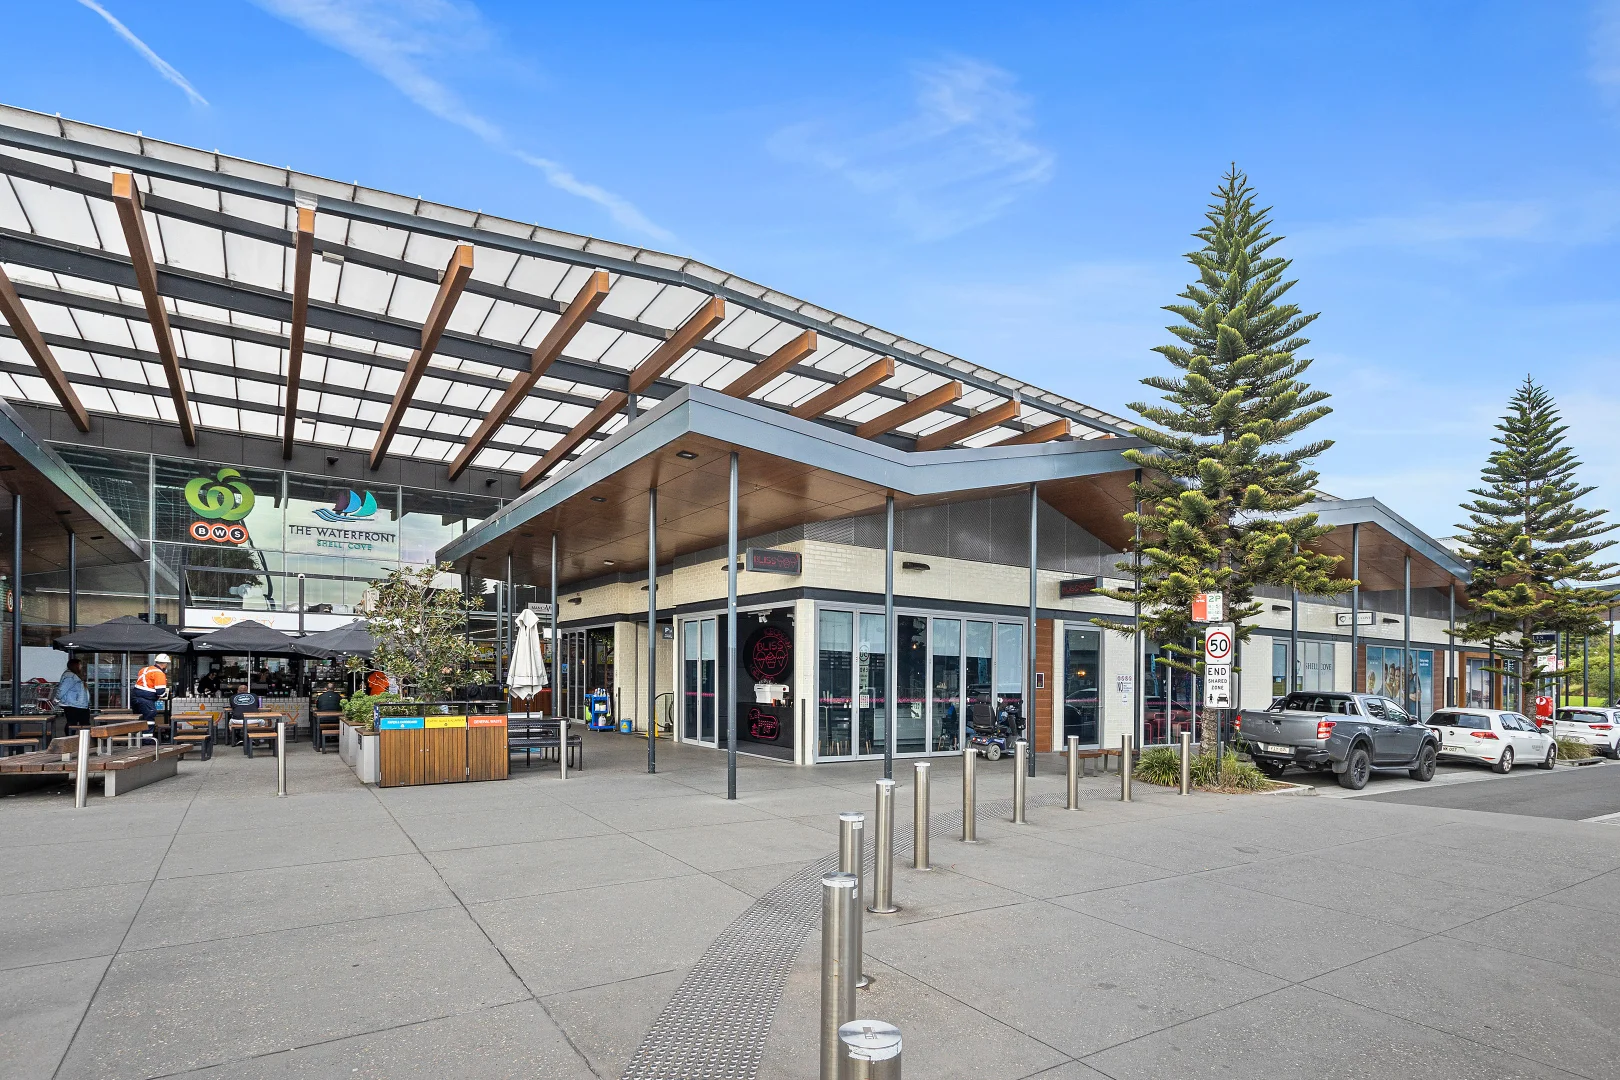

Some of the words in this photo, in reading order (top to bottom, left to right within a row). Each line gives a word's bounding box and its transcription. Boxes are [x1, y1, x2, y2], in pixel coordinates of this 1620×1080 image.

[197, 526, 243, 540] BWS
[288, 524, 311, 535] THE
[316, 527, 396, 543] WATERFRONT
[316, 539, 343, 549] SHELL
[347, 542, 373, 551] COVE
[1208, 595, 1222, 603] 2P
[756, 641, 784, 651] BLISS
[1210, 639, 1228, 652] 50
[1208, 667, 1227, 676] END
